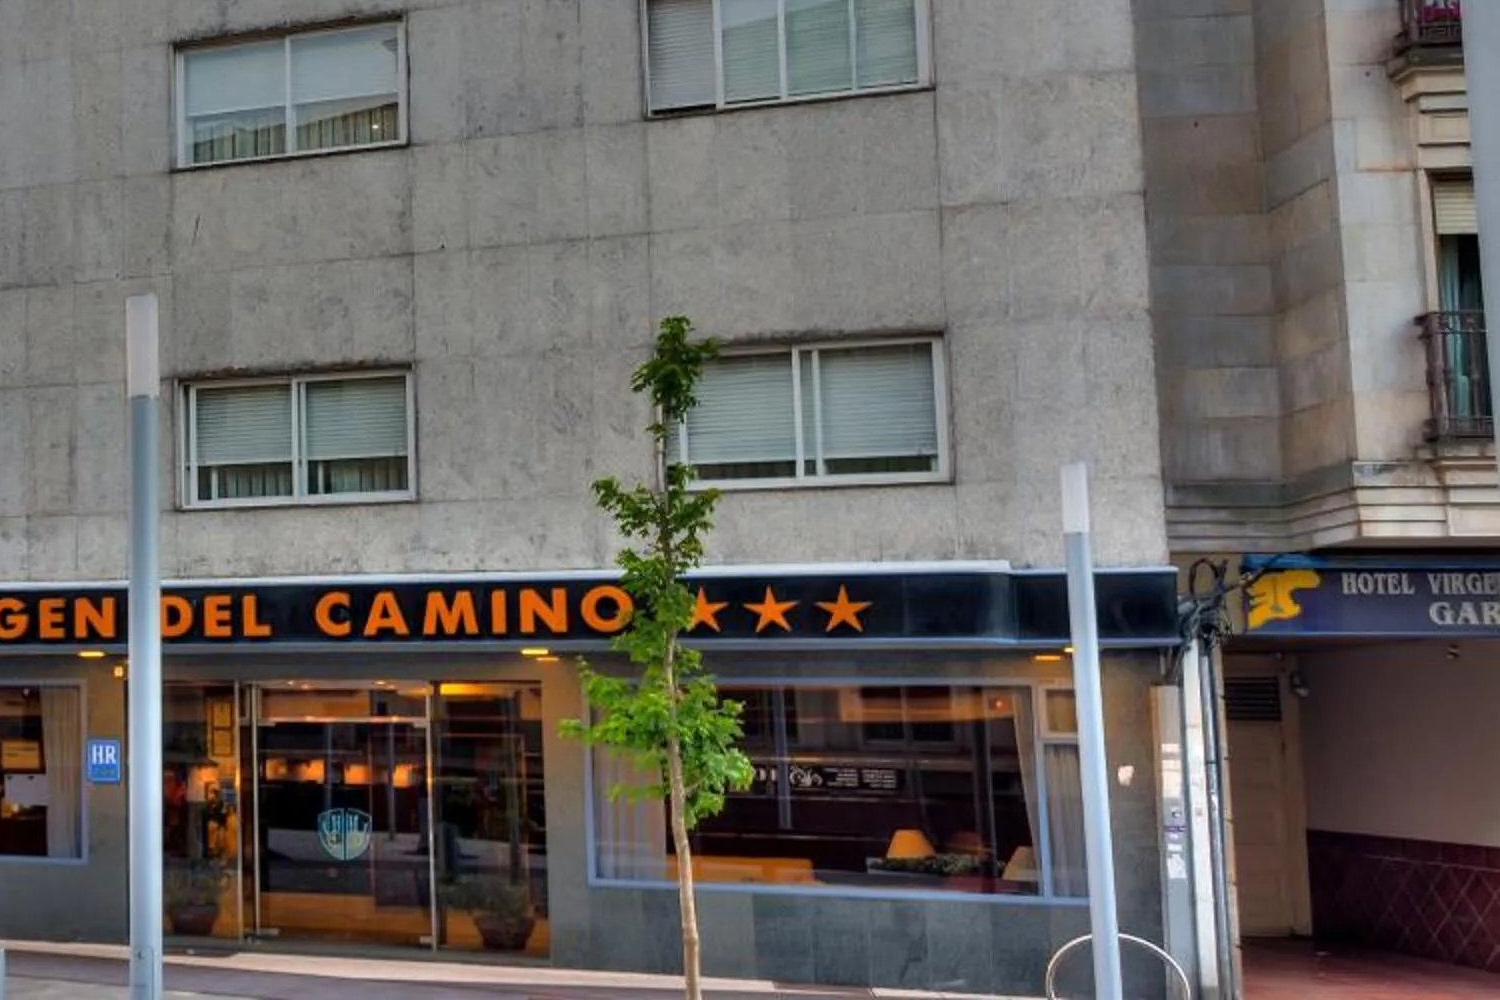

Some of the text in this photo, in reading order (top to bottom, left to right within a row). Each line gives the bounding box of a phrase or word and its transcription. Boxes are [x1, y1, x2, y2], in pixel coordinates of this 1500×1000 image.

[1341, 572, 1500, 595] HOTEL VIRGE
[159, 593, 272, 638] DEL
[314, 584, 634, 637] CAMINO
[1428, 601, 1500, 625] GAR
[92, 743, 117, 765] HR
